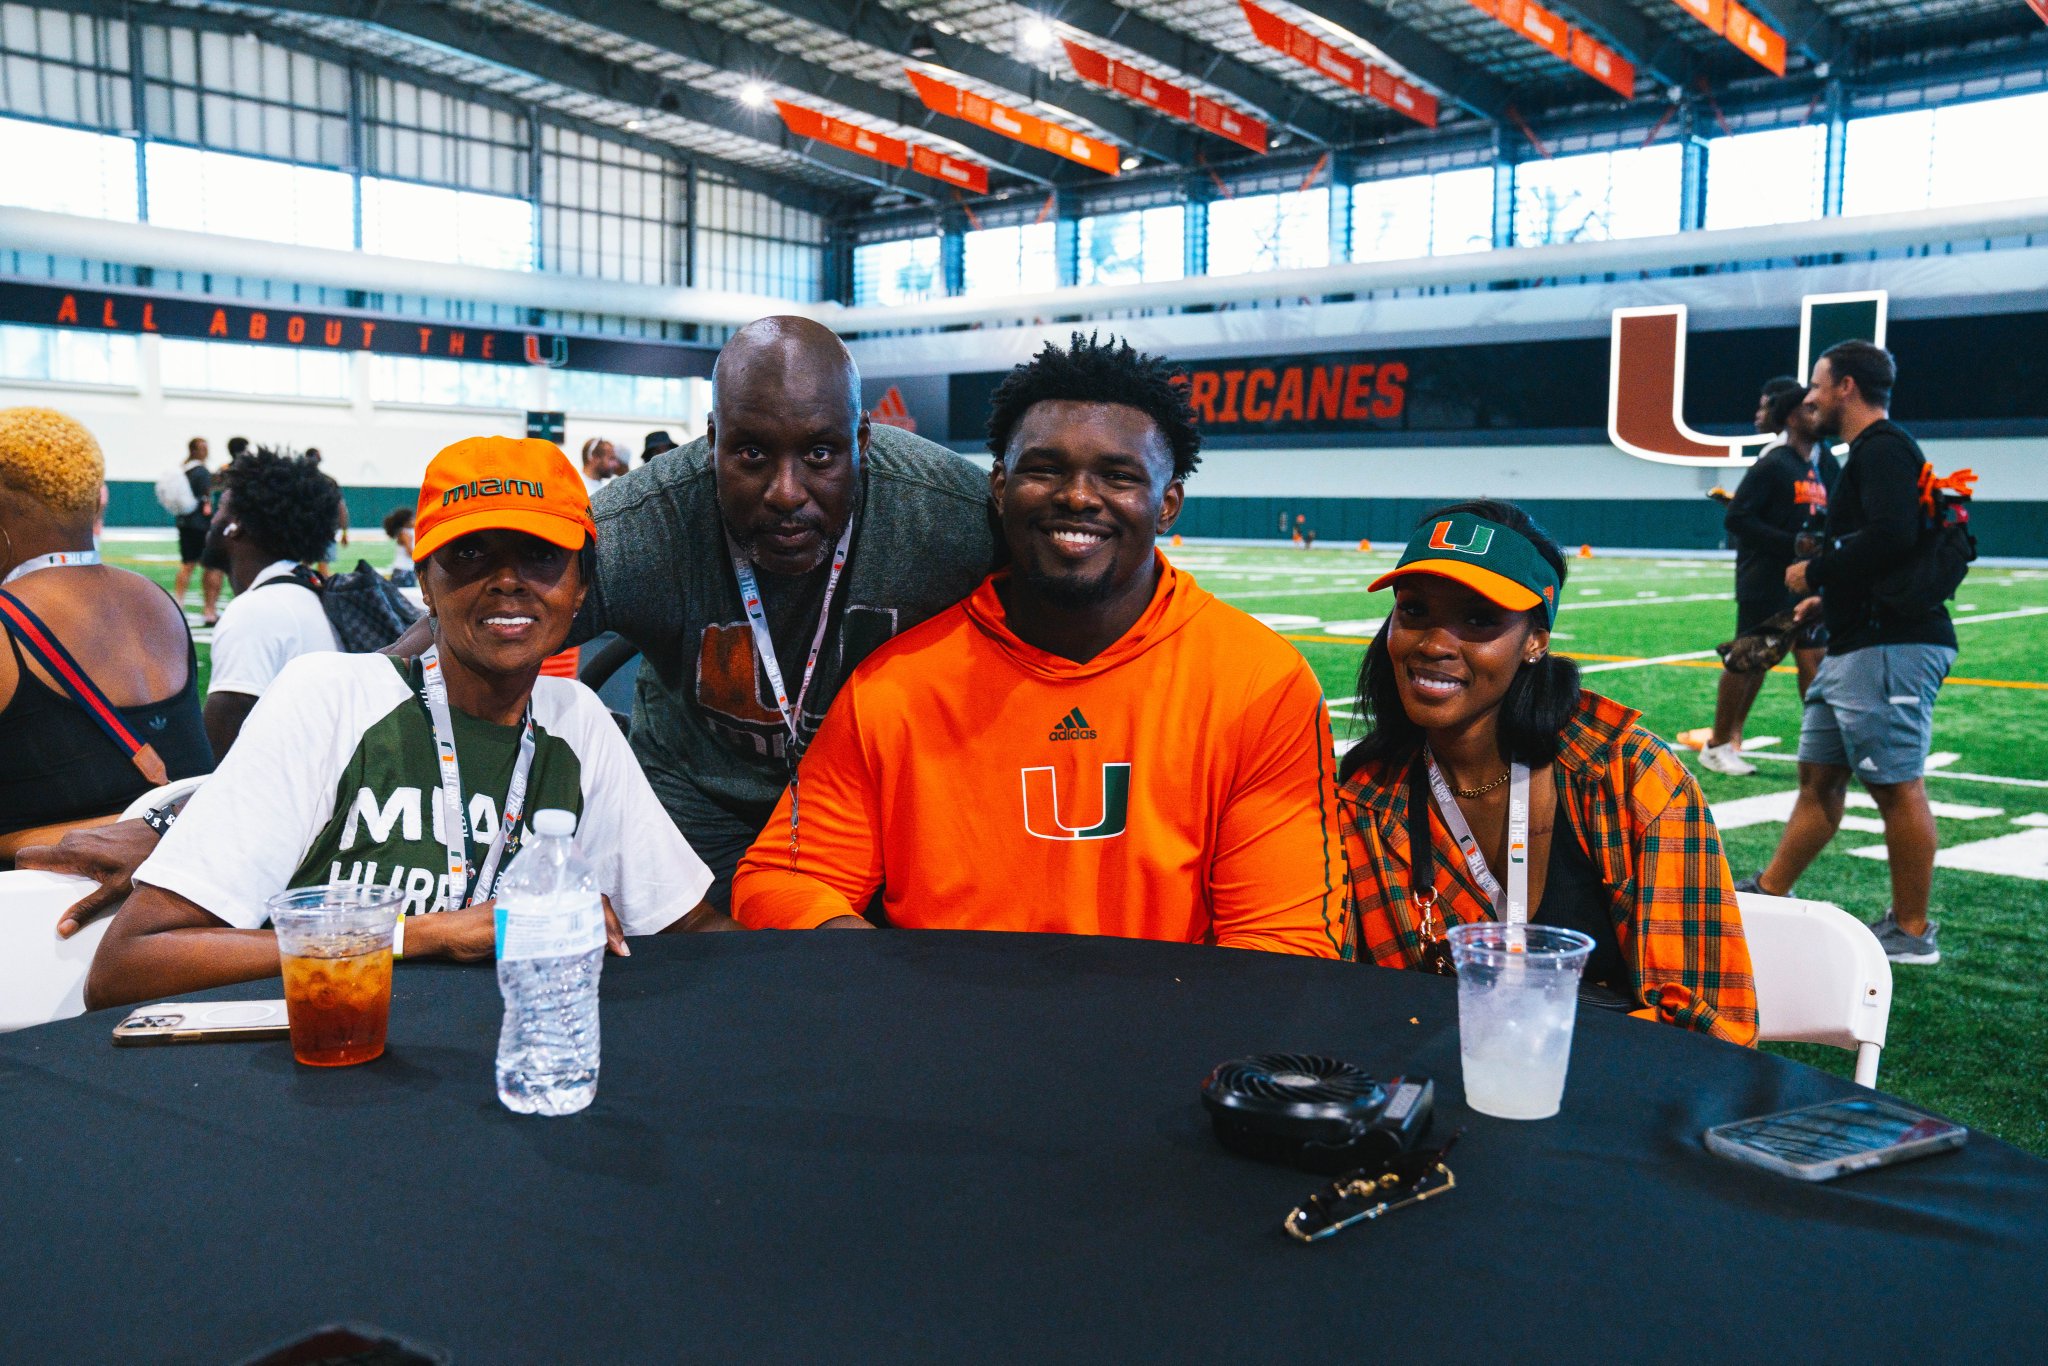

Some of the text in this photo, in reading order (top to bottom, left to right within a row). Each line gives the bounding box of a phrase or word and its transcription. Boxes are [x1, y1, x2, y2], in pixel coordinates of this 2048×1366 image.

[56, 293, 569, 368] ALL ABOUT THE U
[1608, 289, 1888, 468] U
[442, 477, 545, 507] miami
[1428, 519, 1496, 556] U
[1048, 728, 1098, 742] adidas
[1021, 762, 1132, 841] U
[1459, 834, 1478, 858] U
[1511, 821, 1526, 844] THE
[1511, 842, 1525, 864] U
